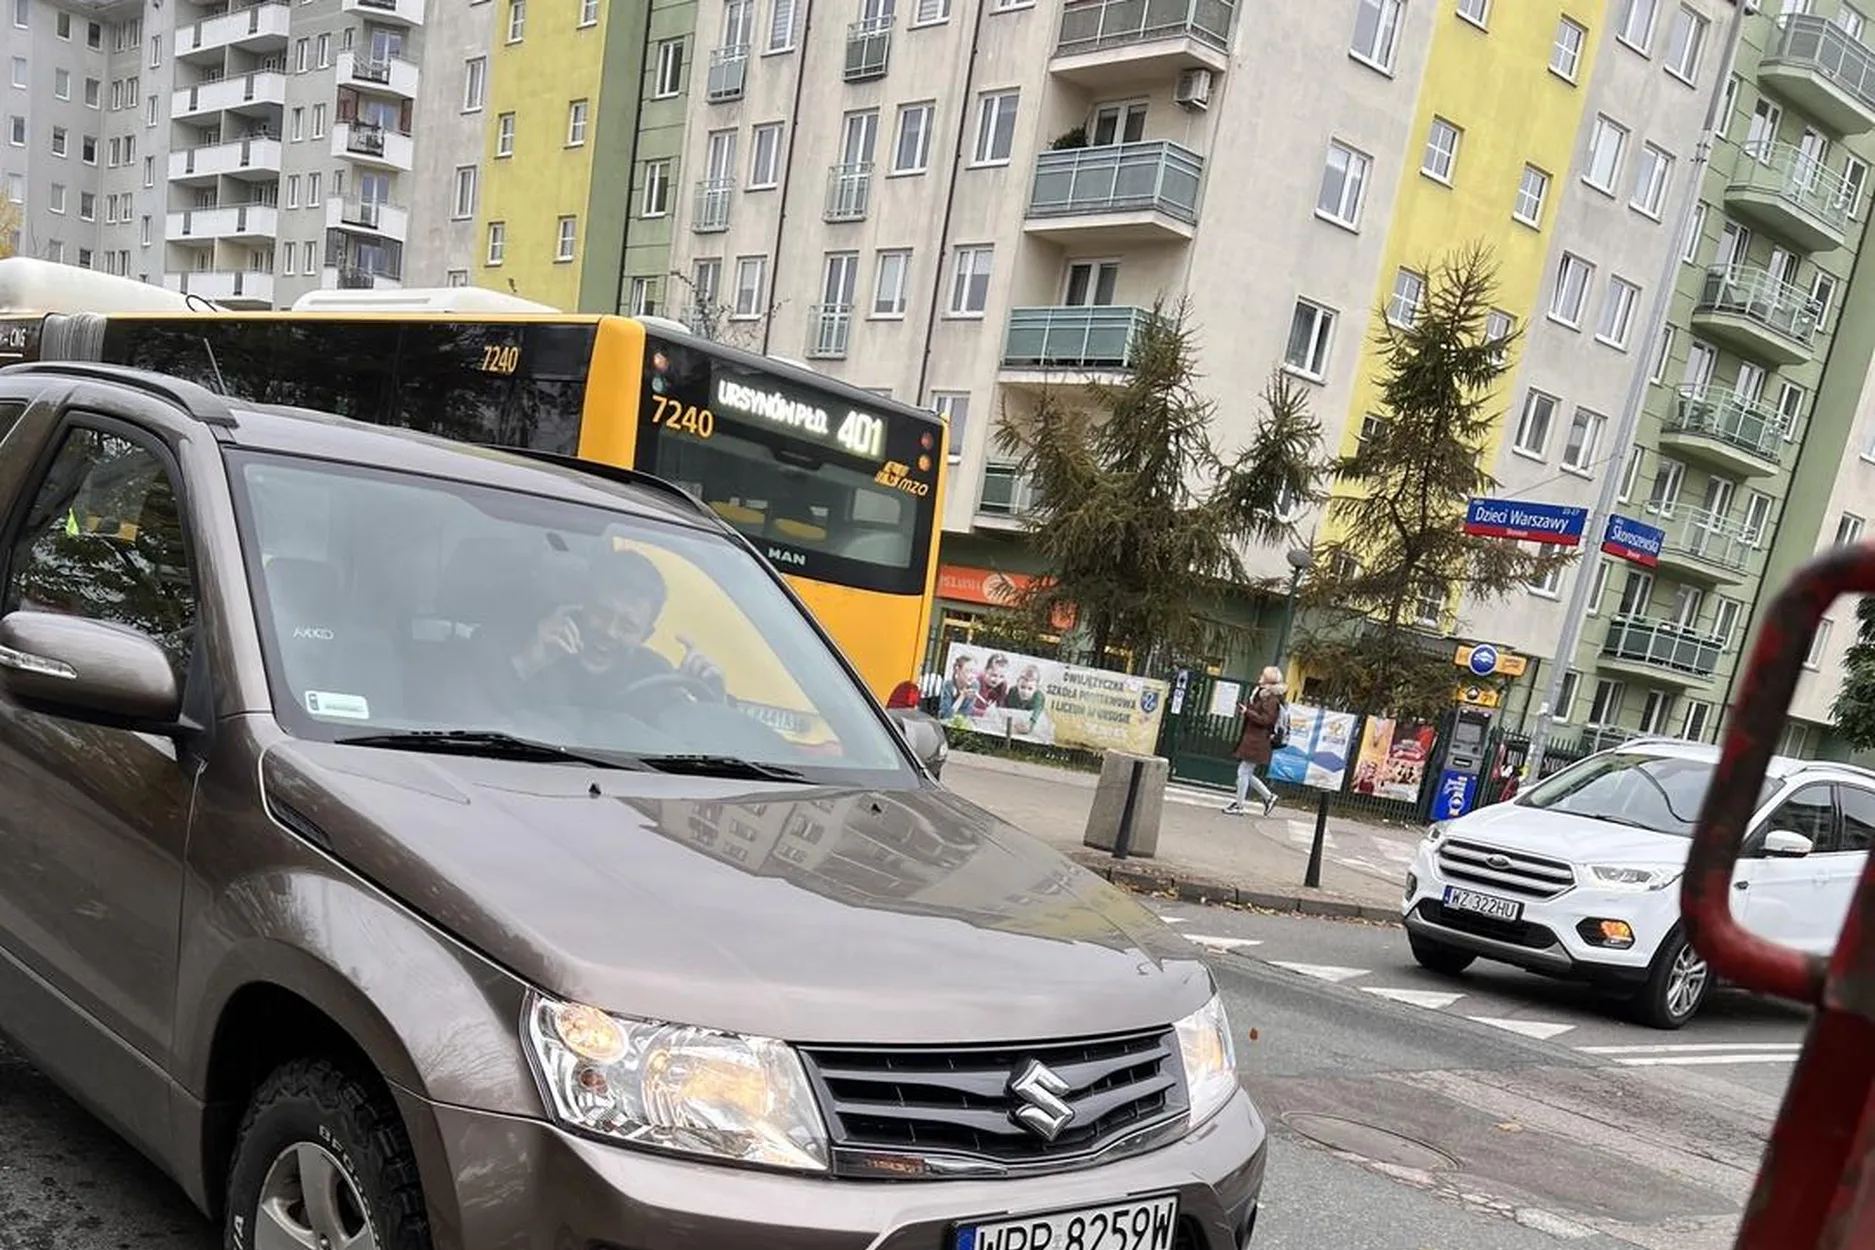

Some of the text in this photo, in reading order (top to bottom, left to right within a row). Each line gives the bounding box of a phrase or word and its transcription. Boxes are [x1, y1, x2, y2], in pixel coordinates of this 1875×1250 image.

[482, 345, 519, 373] 7240
[651, 394, 714, 440] 7240
[718, 379, 794, 426] URSYNÓW
[837, 410, 884, 456] 401
[1475, 506, 1507, 525] Dzieci
[1510, 509, 1570, 534] Warszawy
[768, 547, 806, 566] MAN
[1452, 890, 1517, 918] WZ 322HU
